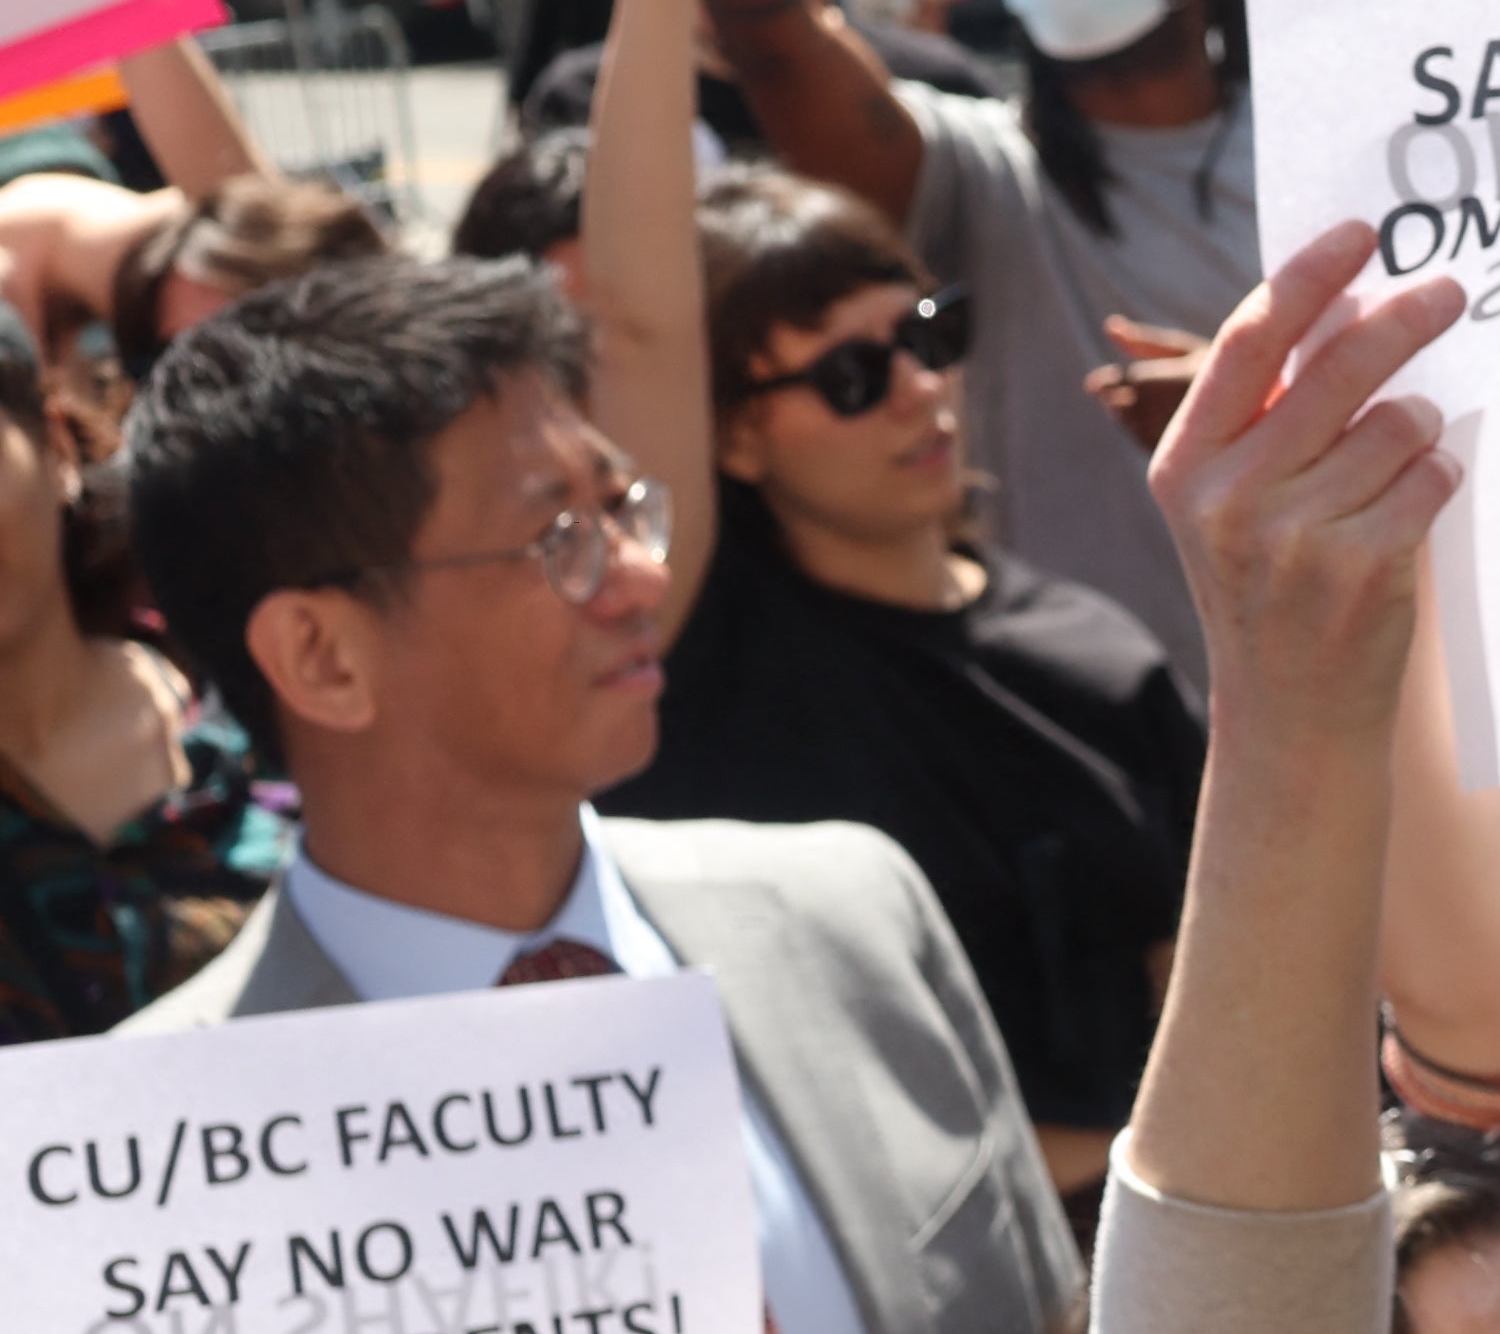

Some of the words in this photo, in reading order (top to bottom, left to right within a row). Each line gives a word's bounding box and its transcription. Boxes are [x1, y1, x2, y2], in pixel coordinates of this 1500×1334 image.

[26, 1114, 311, 1209] CU/BC
[335, 1066, 664, 1168] FACULTY
[102, 1241, 253, 1321] SAY
[288, 1219, 415, 1298] NO
[442, 1189, 634, 1270] WAR
